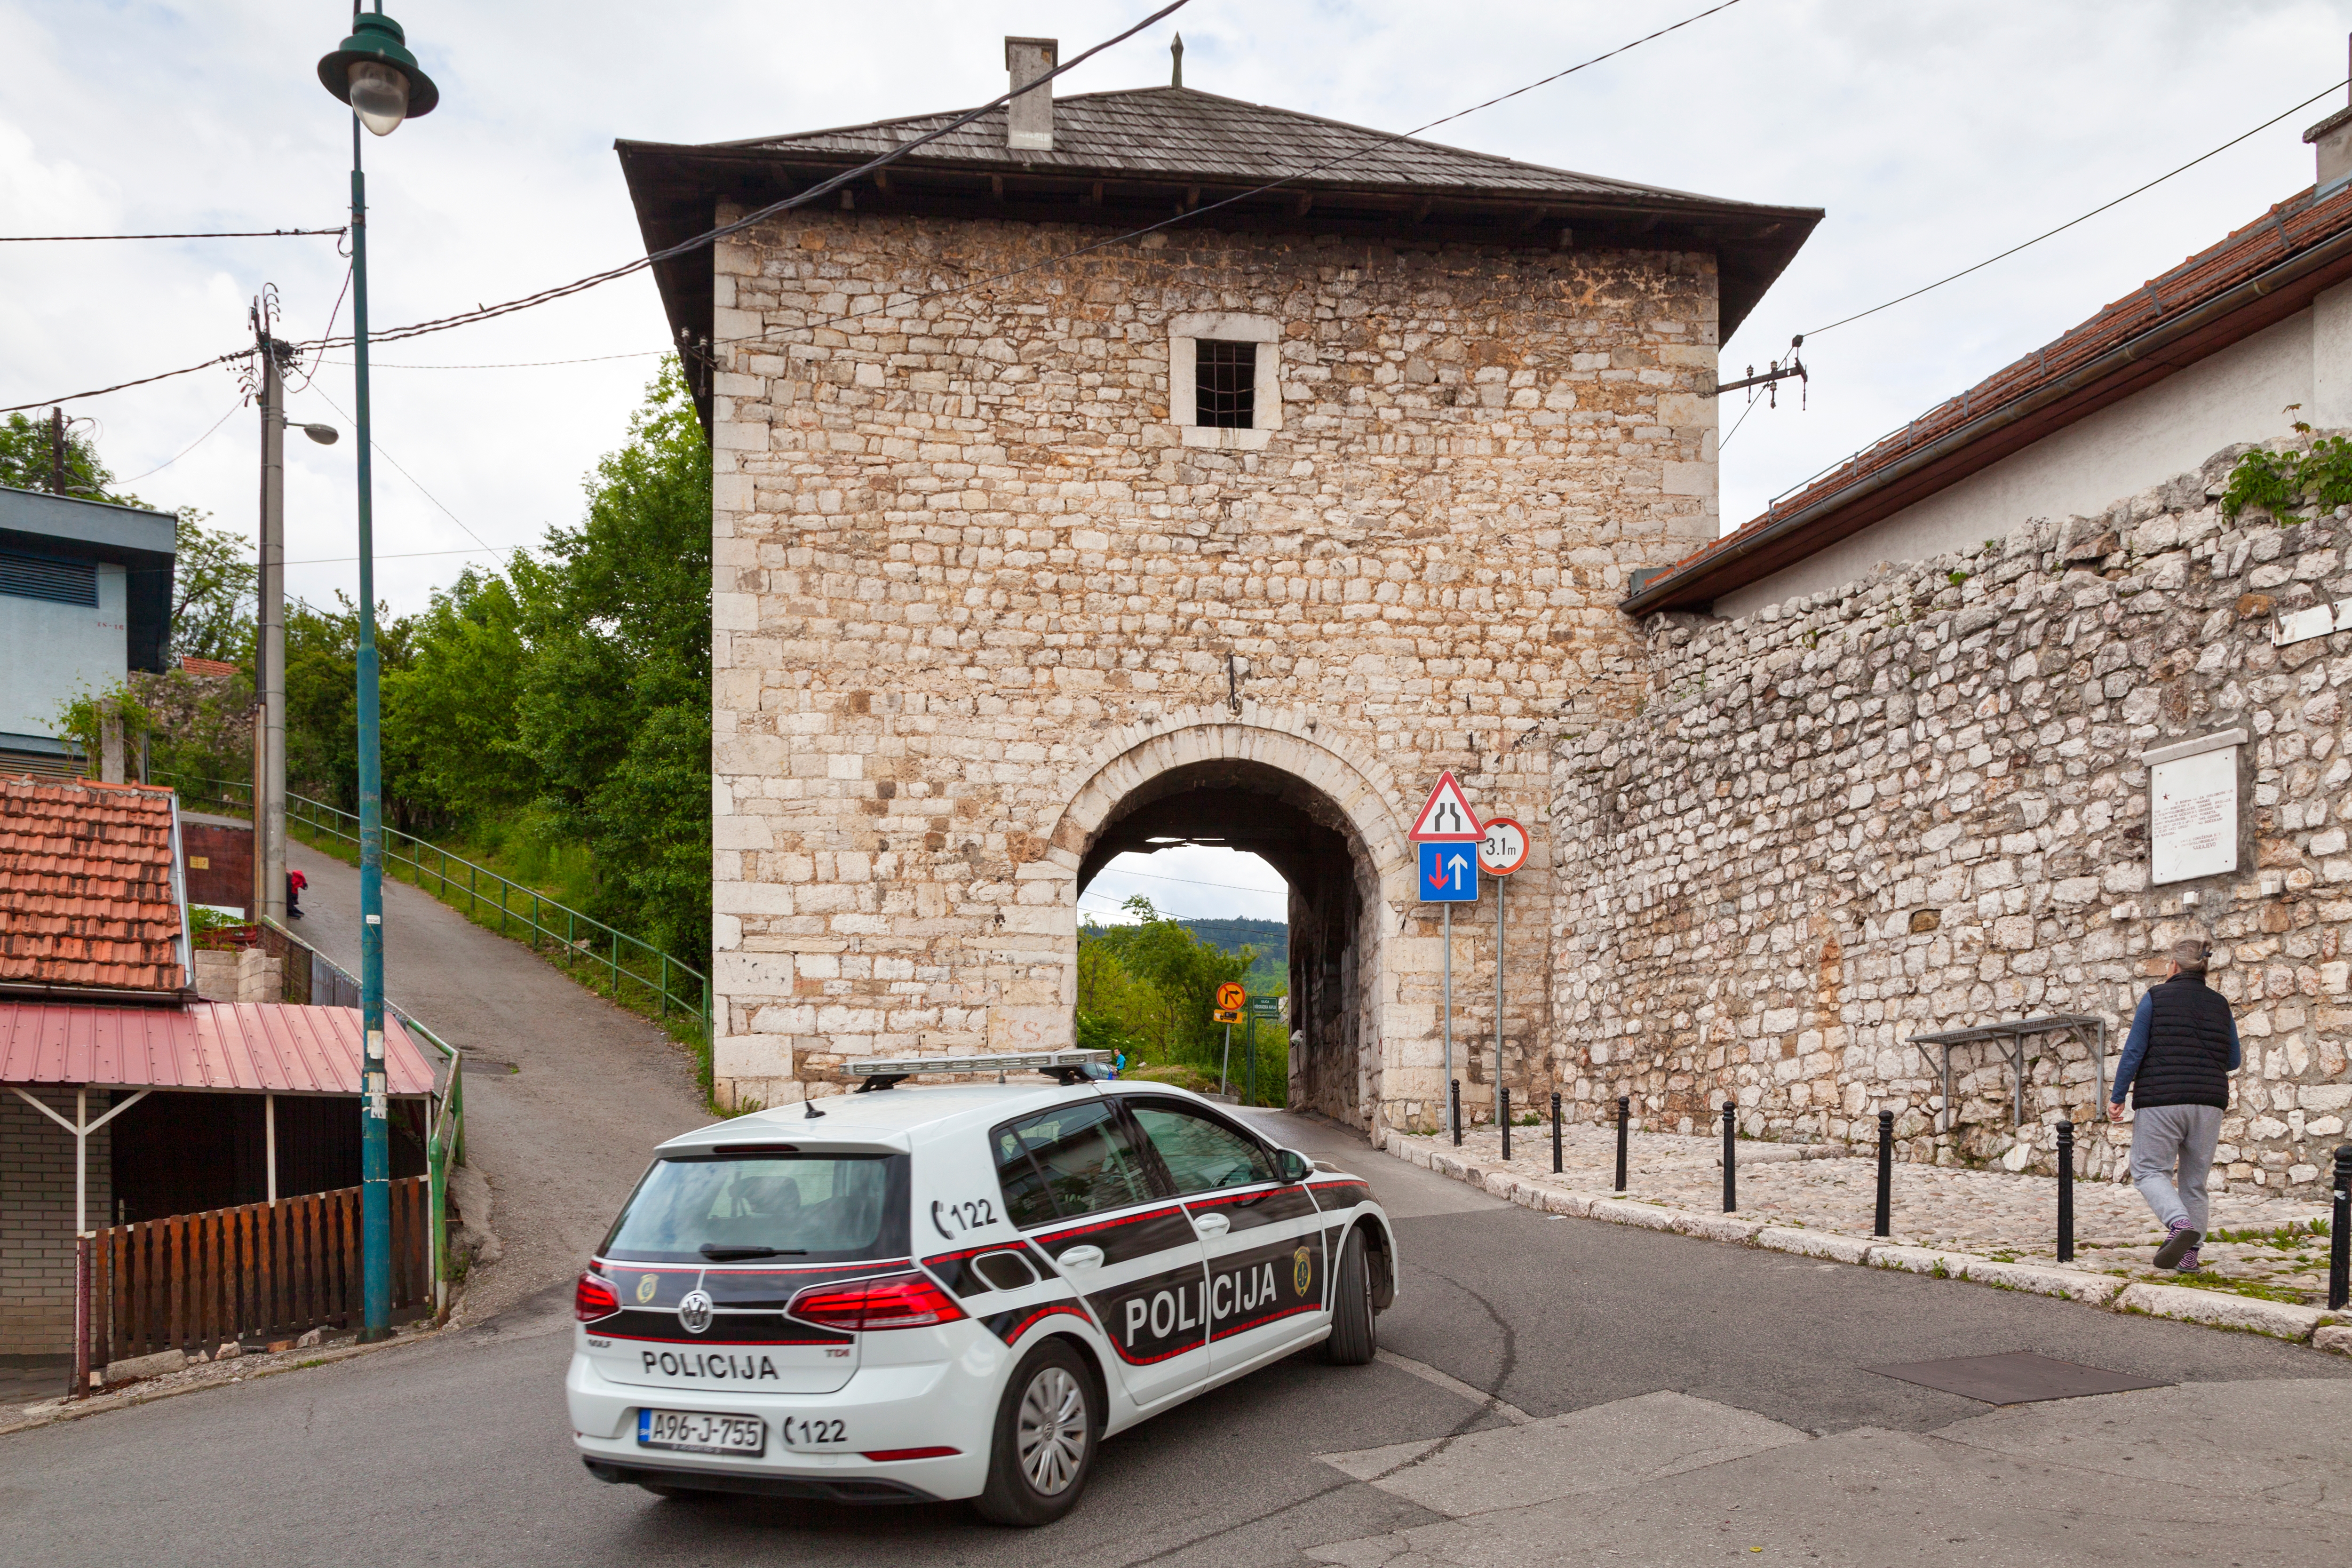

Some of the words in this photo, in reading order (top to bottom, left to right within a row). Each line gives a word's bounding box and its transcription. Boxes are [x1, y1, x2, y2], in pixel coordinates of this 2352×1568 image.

[950, 1199, 999, 1230] 122
[1126, 1263, 1277, 1347] POLICIJA
[642, 1351, 780, 1380] POLICIJA
[824, 1348, 850, 1358] TDI
[652, 1414, 759, 1447] A96-J-755
[798, 1419, 849, 1444] 122
